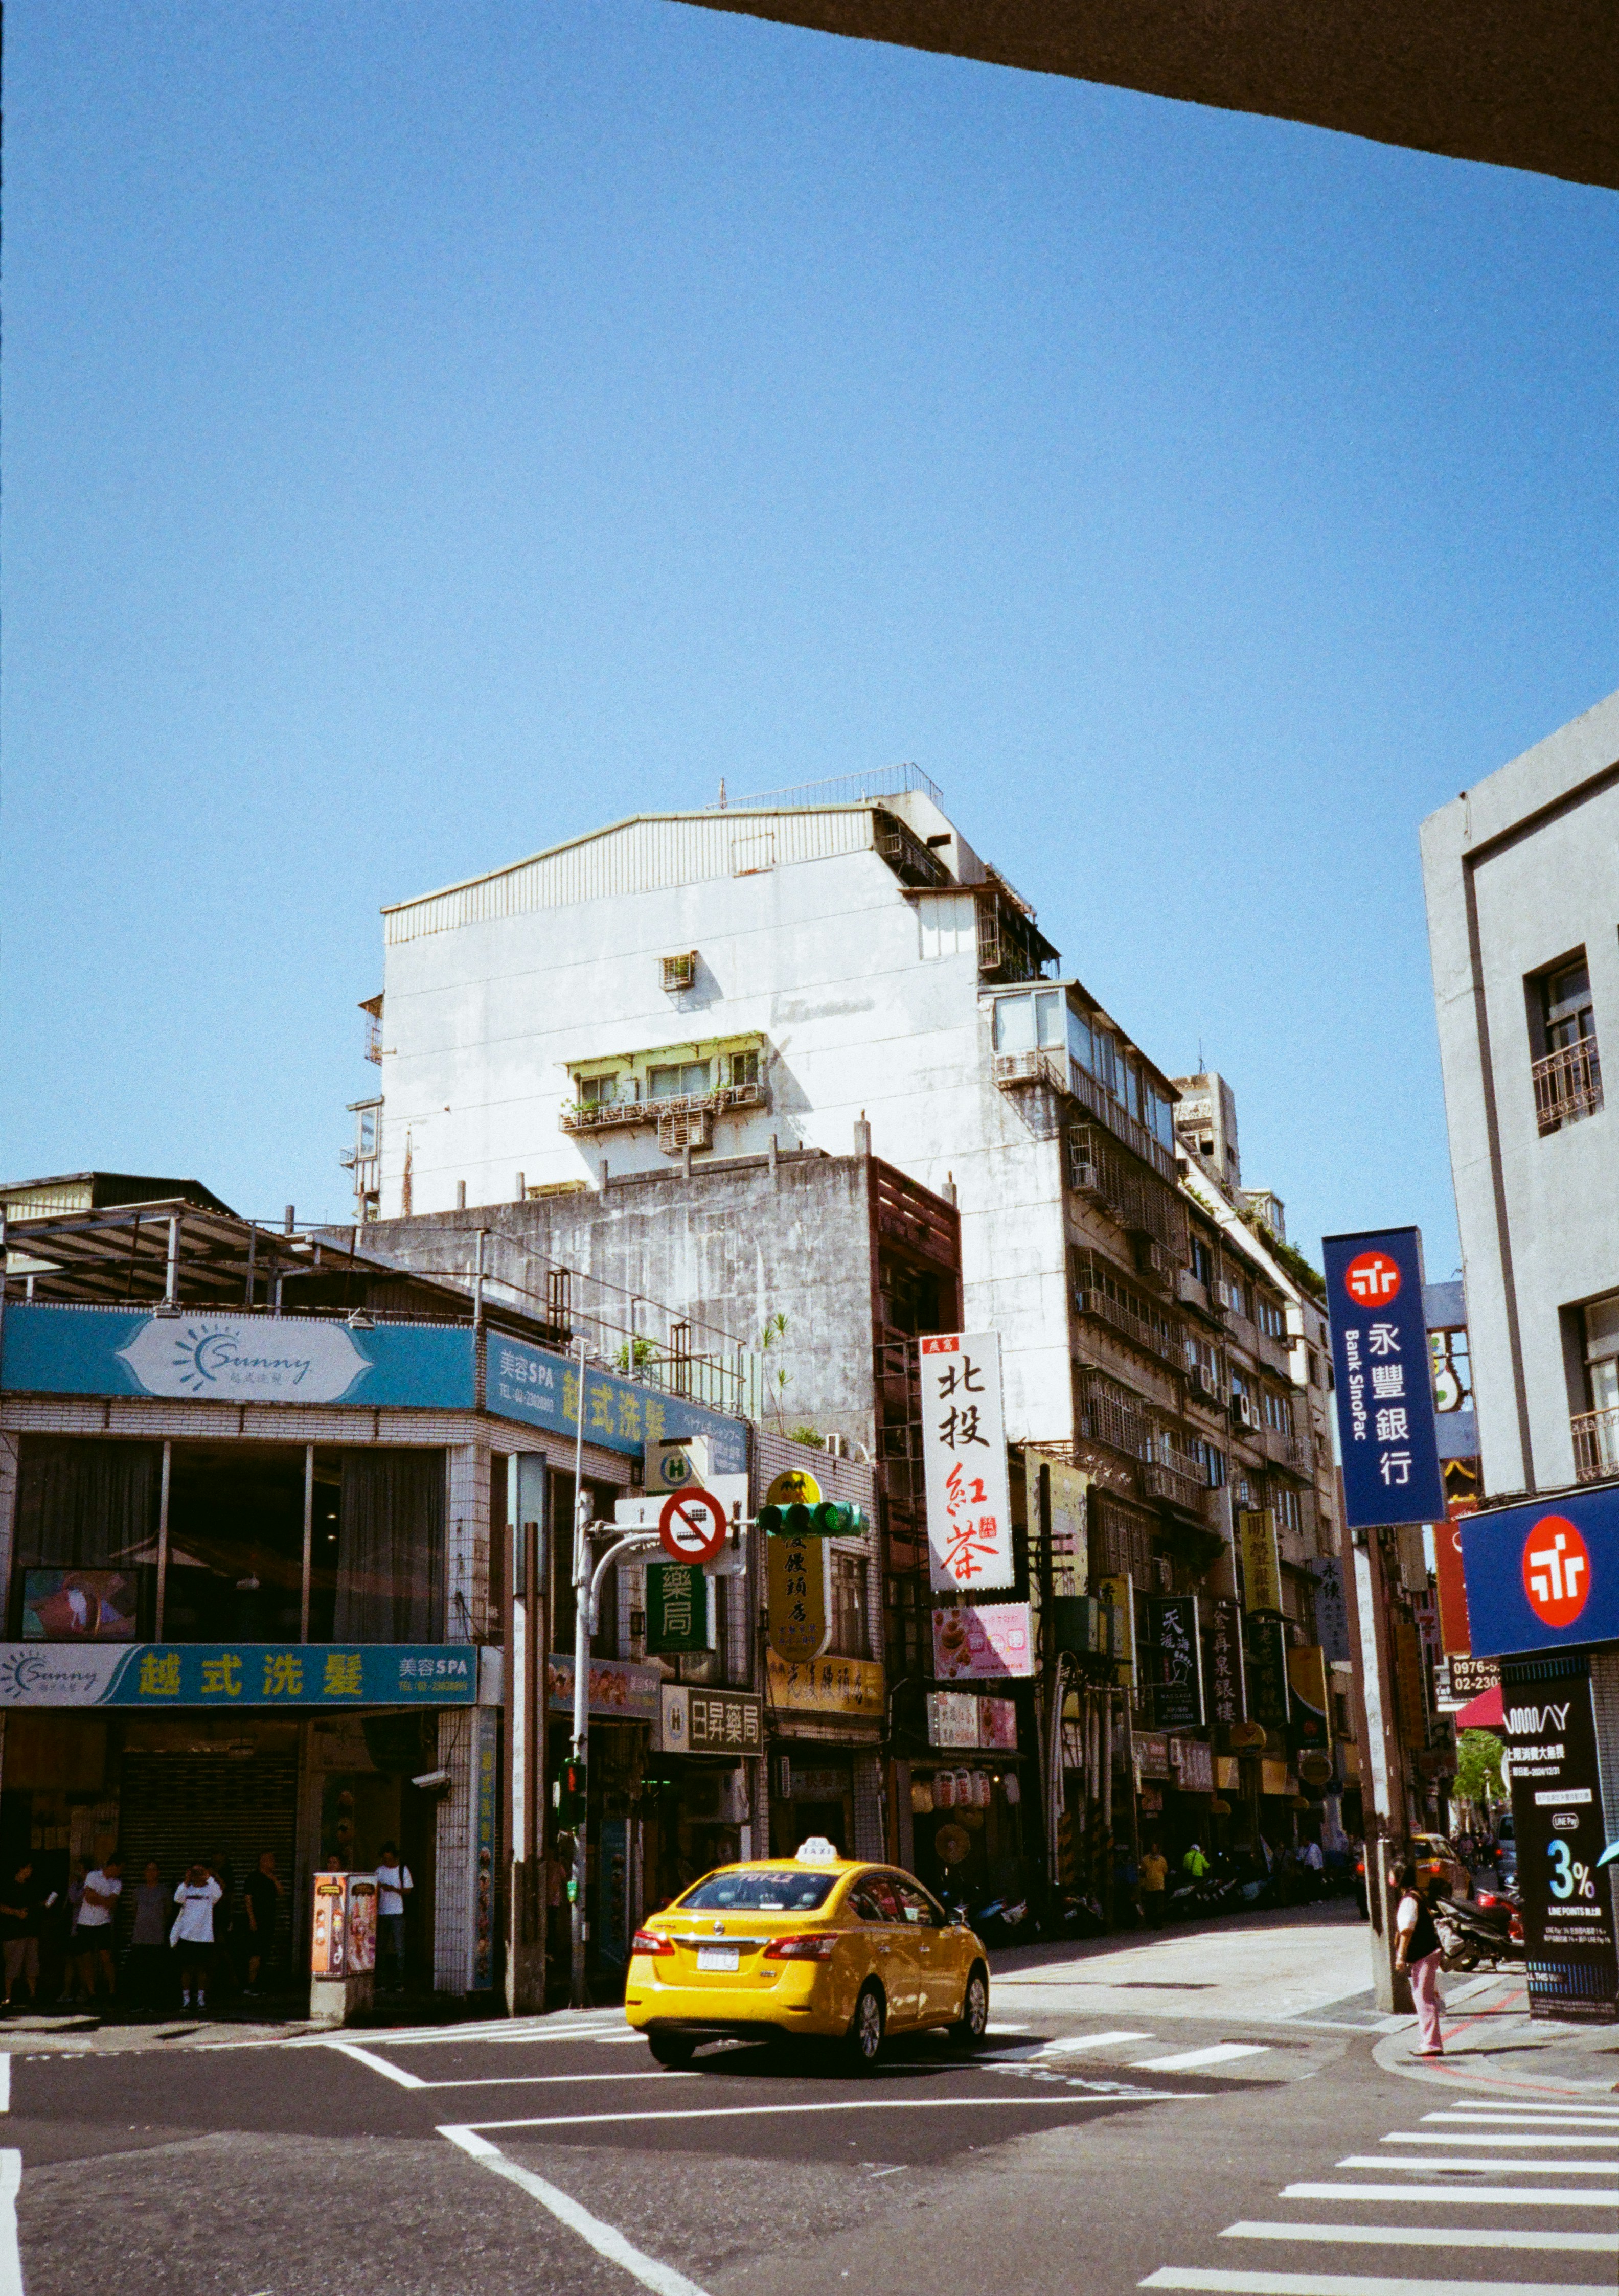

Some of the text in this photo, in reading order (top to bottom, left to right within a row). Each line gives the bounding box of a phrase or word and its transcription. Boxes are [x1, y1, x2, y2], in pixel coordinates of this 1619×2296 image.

[210, 1343, 312, 1385] Sunny
[500, 1349, 554, 1389] 美容SPA
[1345, 1329, 1367, 1441] Bank SinoPac
[563, 1369, 665, 1442] 越式洗髮
[1369, 1323, 1412, 1485] 永豐銀行
[937, 1354, 999, 1580] 北投紅茶
[662, 1564, 692, 1637] 藥局
[27, 1663, 97, 1691] Sunny
[139, 1652, 362, 1695] 越式洗髮
[399, 1657, 468, 1677] 美容SPA
[1212, 1609, 1237, 1723] 金再泉銀樓
[1455, 1675, 1502, 1690] 02-230
[693, 1700, 759, 1745] 日昇藥局
[1555, 1816, 1578, 1828] LINE Pay
[1547, 1840, 1595, 1899] 3%
[1548, 1906, 1562, 1916] LINE
[1562, 1906, 1585, 1917] POINTS
